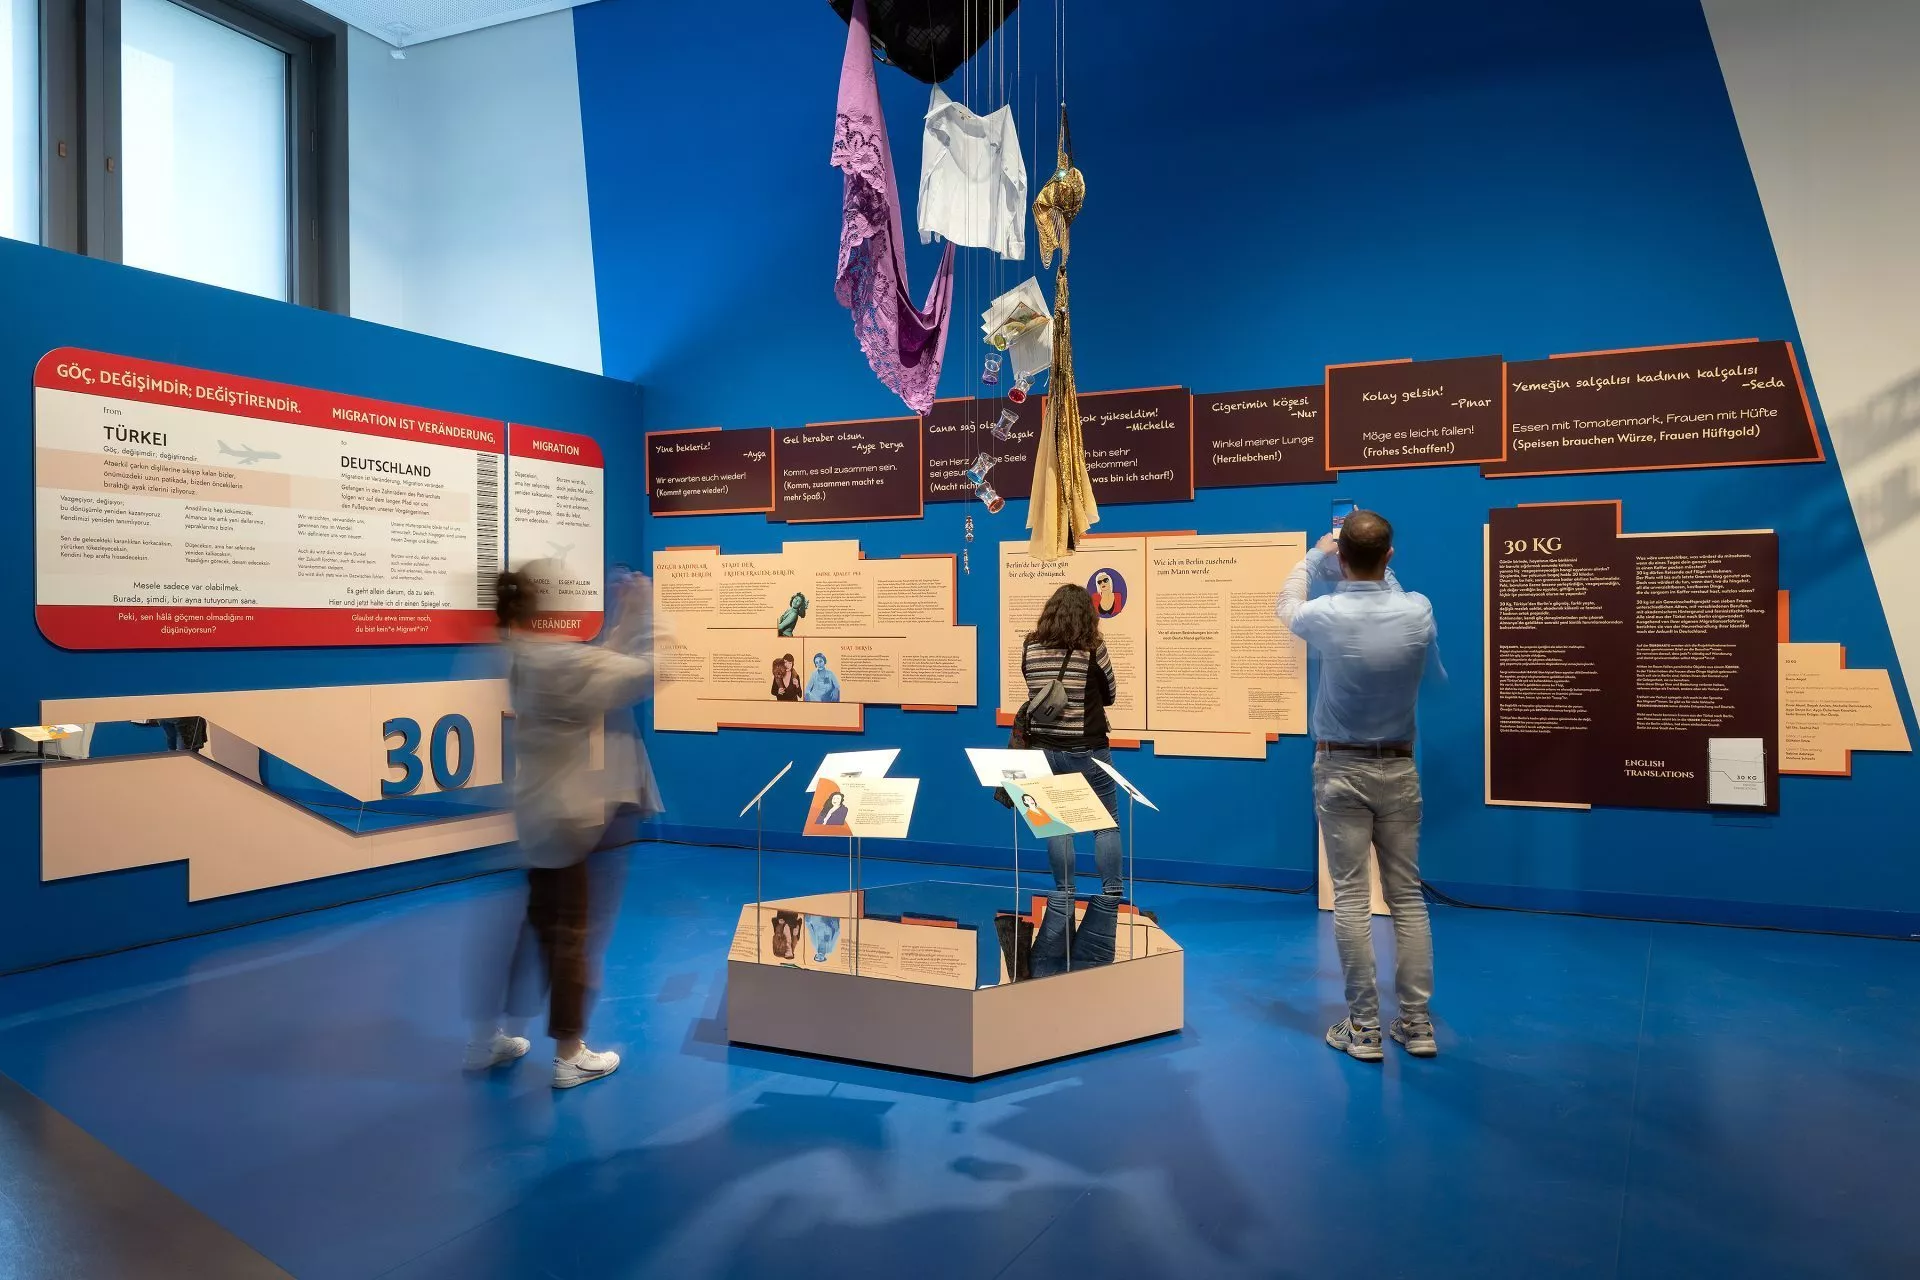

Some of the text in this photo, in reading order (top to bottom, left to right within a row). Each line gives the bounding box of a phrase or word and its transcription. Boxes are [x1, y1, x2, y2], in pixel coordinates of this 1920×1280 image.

[56, 363, 302, 413] GÖÇ, DEĞİŞİMDİR; DEĞİŞTİRENDİR.
[1512, 380, 1571, 393] Yemeğin
[1741, 377, 1786, 390] -Seda
[1362, 385, 1443, 405] Kolay gelsin!
[103, 406, 122, 415] from
[1100, 408, 1158, 425] yükseldim!
[1290, 409, 1318, 418] -Nur
[332, 408, 496, 444] MIGRATION IST VERÄNDERUNG,
[979, 421, 996, 430] ols
[1125, 420, 1176, 431] -Michelle
[1512, 407, 1778, 433] Essen mit Tomatenmark, Frauen mit Hüfte
[103, 424, 167, 446] TÜRKEI
[782, 435, 800, 444] Gel
[802, 433, 835, 443] beraber
[1362, 425, 1474, 442] Möge es leicht fallen!
[1512, 424, 1761, 451] (Speisen brauchen Würze, Frauen Hüftgold)
[532, 440, 580, 455] MIGRATION
[879, 441, 905, 452] Derya
[1212, 436, 1314, 448] Winkel meiner Lunge
[1092, 449, 1107, 458] bin
[1108, 447, 1131, 457] sehr
[1363, 441, 1455, 458] (Frohes Schaffen!)
[929, 459, 948, 467] Dein
[1004, 454, 1027, 462] Seele
[1212, 450, 1282, 465] (Herzliebchen!)
[341, 455, 431, 477] DEUTSCHLAND
[809, 468, 819, 476] es
[819, 466, 833, 475] soll
[833, 465, 878, 474] zusammen
[878, 463, 898, 472] sein.
[1085, 458, 1138, 472] gekommen!
[667, 476, 701, 484] erwarten
[701, 473, 720, 482] euch
[719, 472, 746, 480] wieder!
[929, 470, 942, 478] sei
[1110, 474, 1124, 482] bin
[1125, 472, 1139, 481] ich
[1140, 469, 1174, 481] scharf!)
[783, 480, 811, 491] (Komm,
[812, 480, 851, 488] zusammen
[851, 477, 875, 486] macht
[930, 482, 958, 493] (Macht
[656, 484, 729, 498] (Kommt gerne wieder!)
[783, 493, 802, 501] mehr
[1504, 537, 1562, 555] 30 KG
[1153, 558, 1166, 566] Wie
[1167, 558, 1177, 566] ich
[1185, 557, 1204, 565] Berlin
[1205, 557, 1237, 565] zusehends
[133, 581, 161, 590] Mesele
[163, 582, 190, 590] sadece
[204, 582, 242, 591] olabilmek.
[354, 587, 369, 596] geht
[369, 587, 385, 595] allein
[386, 588, 406, 596] darum,
[407, 588, 415, 596] da
[113, 594, 144, 604] Burada,
[146, 595, 170, 605] şimdi,
[172, 595, 183, 604] bir
[184, 597, 202, 606] ayna
[203, 597, 239, 606] tutuyorum
[328, 599, 343, 608] Hier
[343, 599, 356, 608] und
[356, 599, 369, 609] jetzt
[385, 599, 394, 607] ich
[394, 599, 403, 607] dir
[404, 599, 420, 607] einen
[420, 600, 441, 608] Spiegel
[118, 612, 138, 622] Peki,
[156, 612, 172, 621] hâlâ
[173, 613, 204, 623] göçmen
[351, 613, 374, 621] Glaubst
[374, 613, 383, 621] du
[416, 614, 432, 622] noch,
[531, 617, 582, 629] VERÄNDERT
[160, 625, 217, 635] düşünüyorsun?
[355, 625, 364, 633] du
[363, 625, 376, 633] bist
[380, 713, 475, 796] 30
[1625, 759, 1665, 767] ENGLISH
[1623, 769, 1695, 779] TRANSLATIONS
